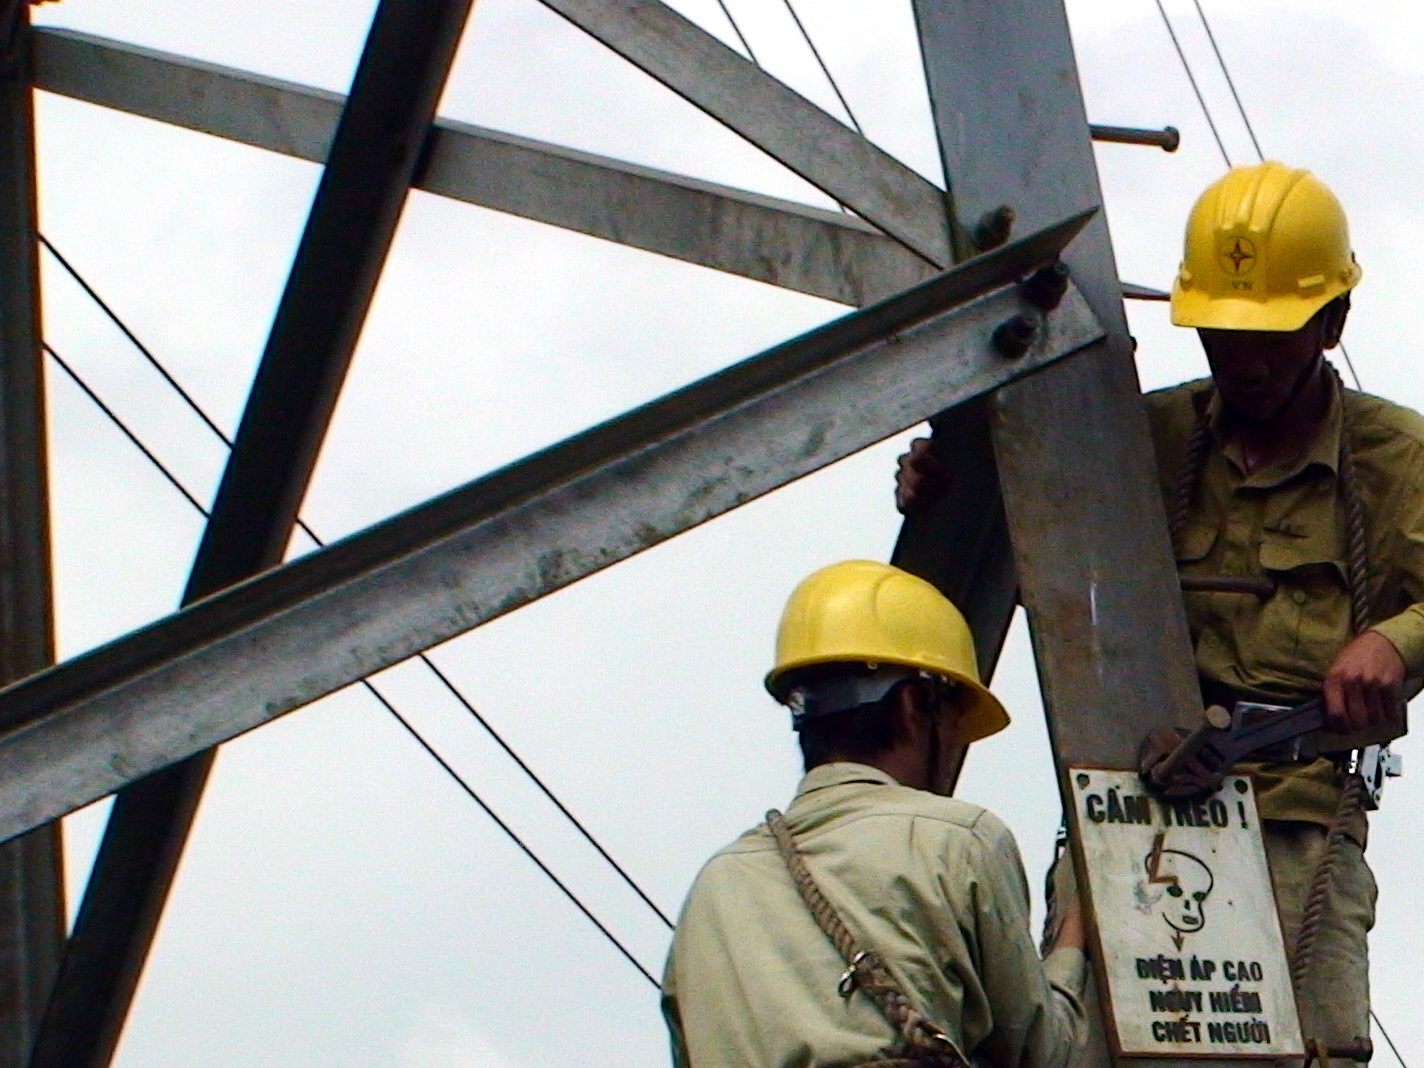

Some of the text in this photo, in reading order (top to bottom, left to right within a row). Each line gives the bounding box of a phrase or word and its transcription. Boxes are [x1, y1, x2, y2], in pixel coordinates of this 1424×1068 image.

[1190, 955, 1216, 981] ÁP
[1222, 960, 1263, 982] CAO
[1149, 990, 1202, 1013] NGUY
[1151, 1014, 1271, 1044] CHẾT NGƯỜI
